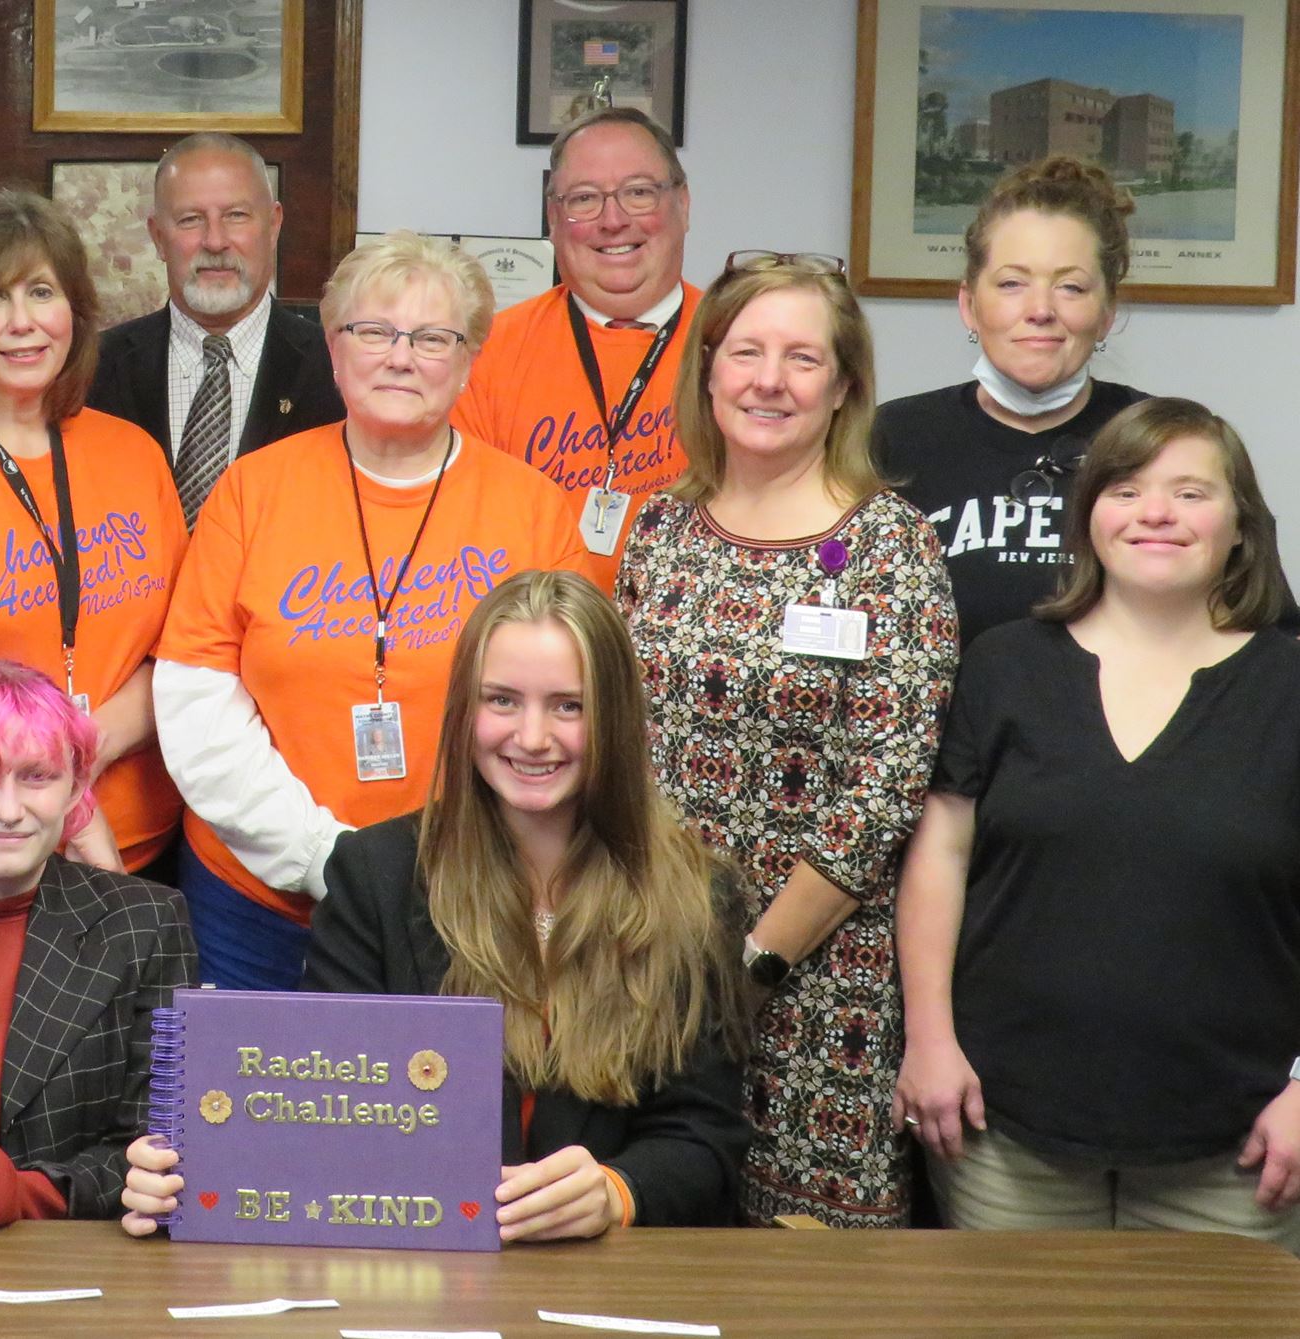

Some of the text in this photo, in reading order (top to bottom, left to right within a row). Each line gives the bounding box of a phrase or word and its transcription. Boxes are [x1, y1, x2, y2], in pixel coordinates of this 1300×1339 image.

[927, 245, 965, 253] WAYN
[1178, 250, 1222, 258] ANNEX
[998, 551, 1075, 565] NEW JERS
[278, 545, 511, 621] Challenge
[237, 1046, 390, 1084] Rachels
[244, 1091, 440, 1135] Challenge
[235, 1189, 443, 1227] BE KIND
